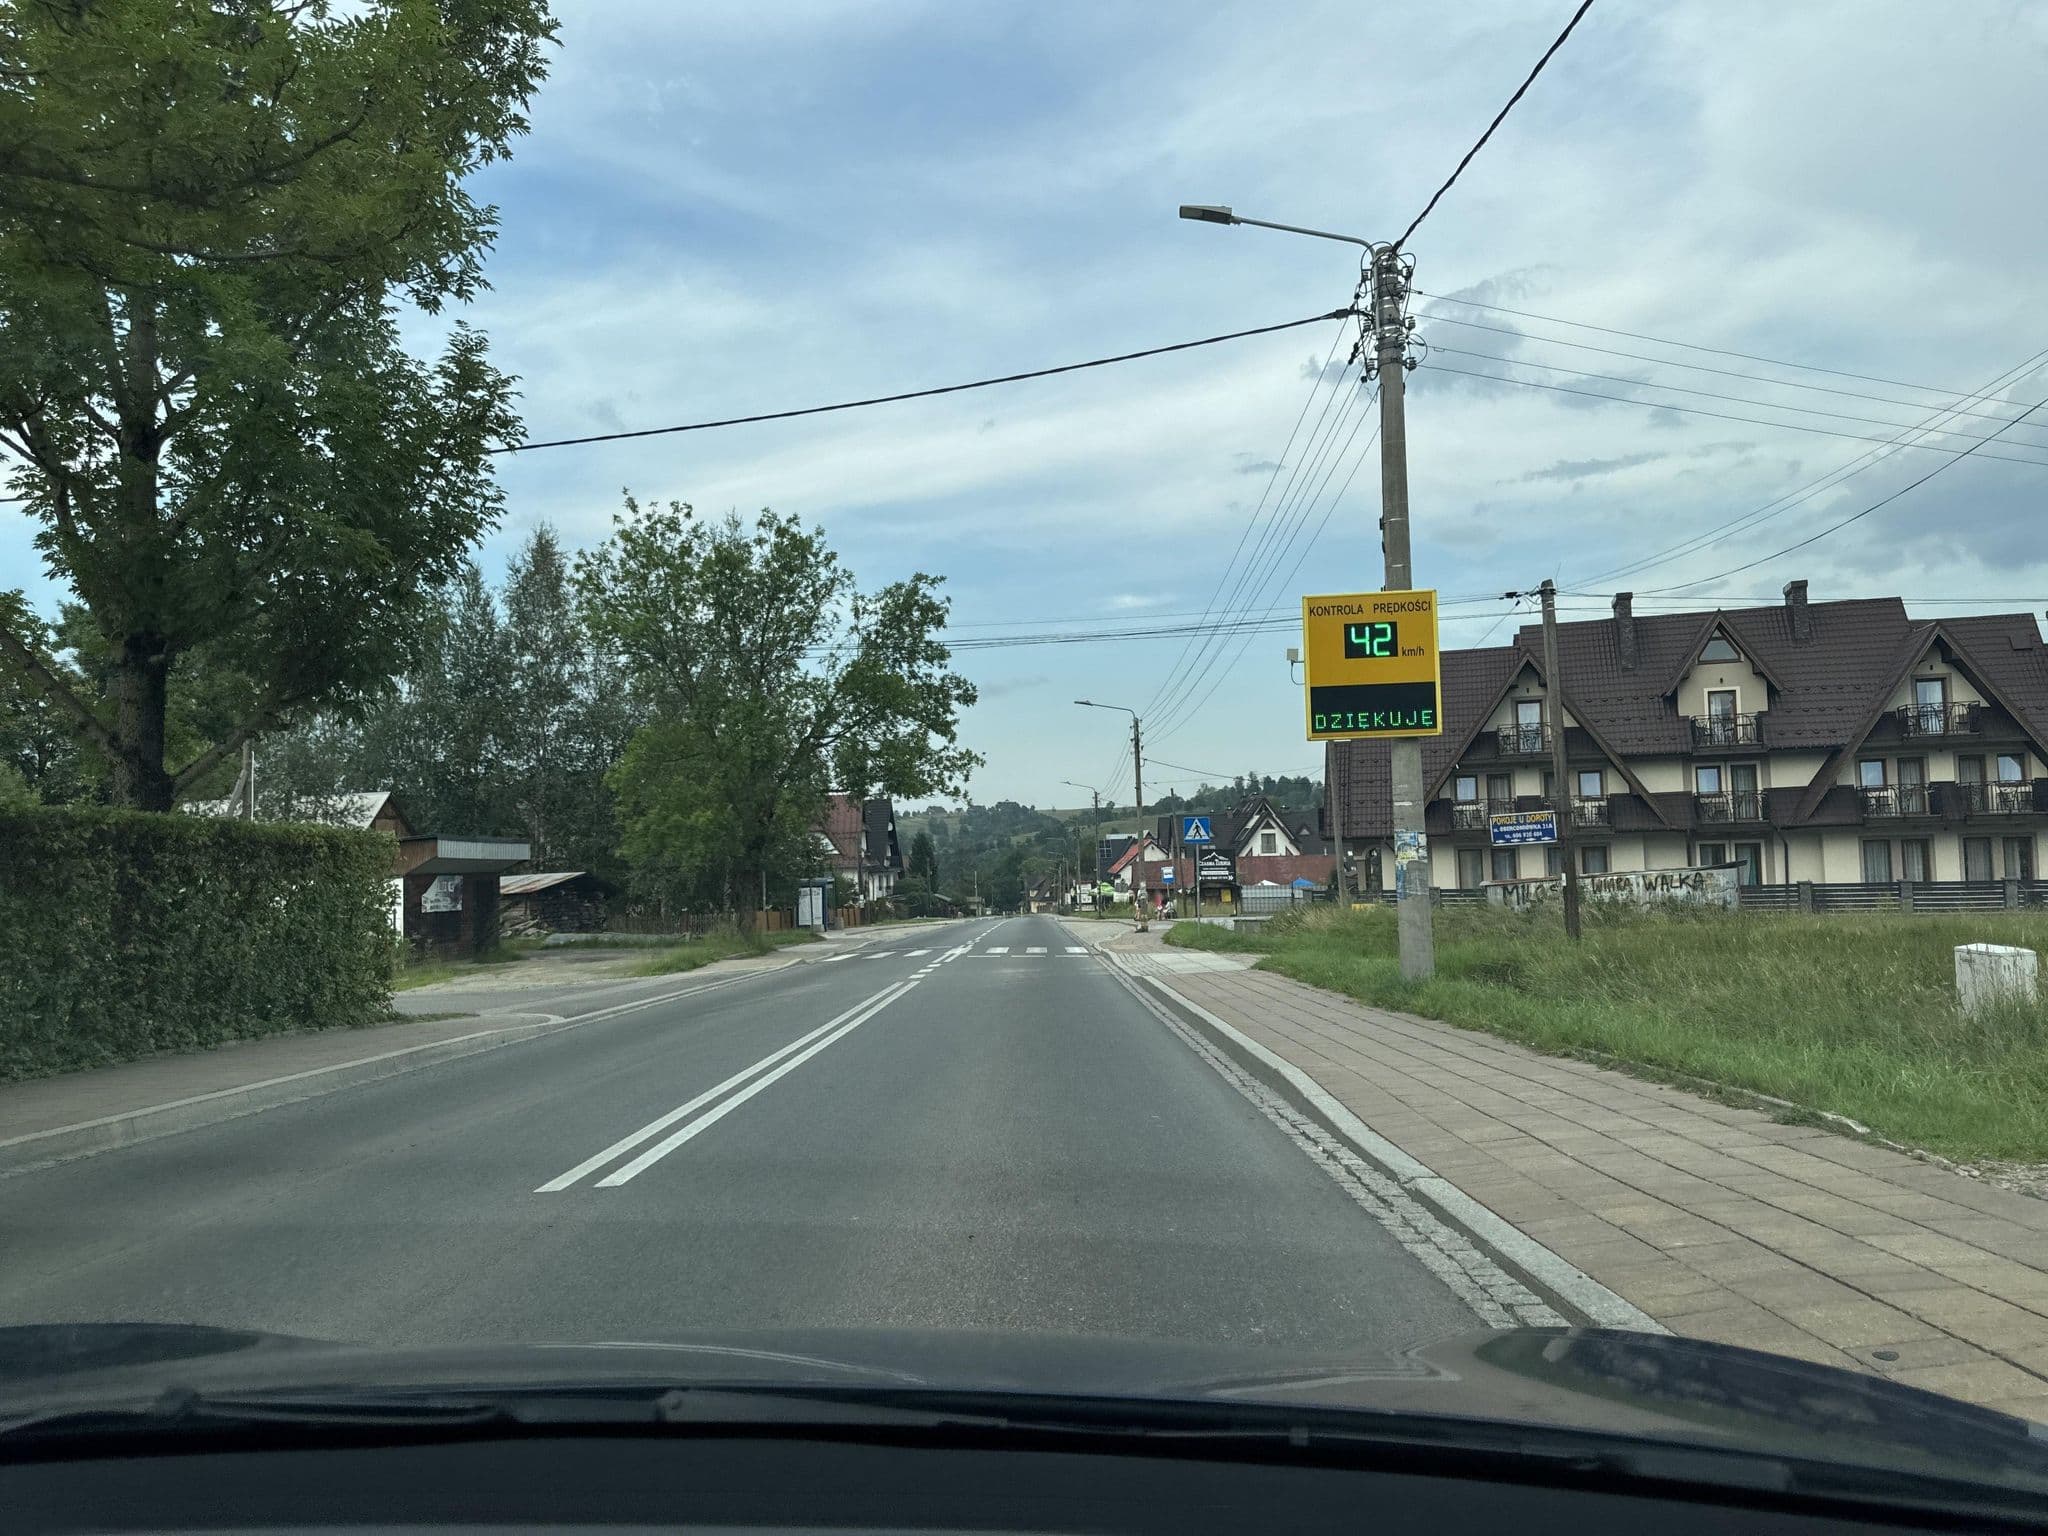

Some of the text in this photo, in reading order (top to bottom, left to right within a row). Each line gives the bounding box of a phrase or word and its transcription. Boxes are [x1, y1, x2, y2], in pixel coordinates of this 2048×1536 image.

[1309, 599, 1431, 617] KONTROLA PRĘDKOŚCI
[1350, 623, 1392, 657] 42
[1401, 645, 1425, 657] km/h
[1315, 710, 1433, 729] DZIĘKUJĘ
[1492, 813, 1552, 825] POKOJE U DOROTY
[1642, 871, 1705, 892] WALKA
